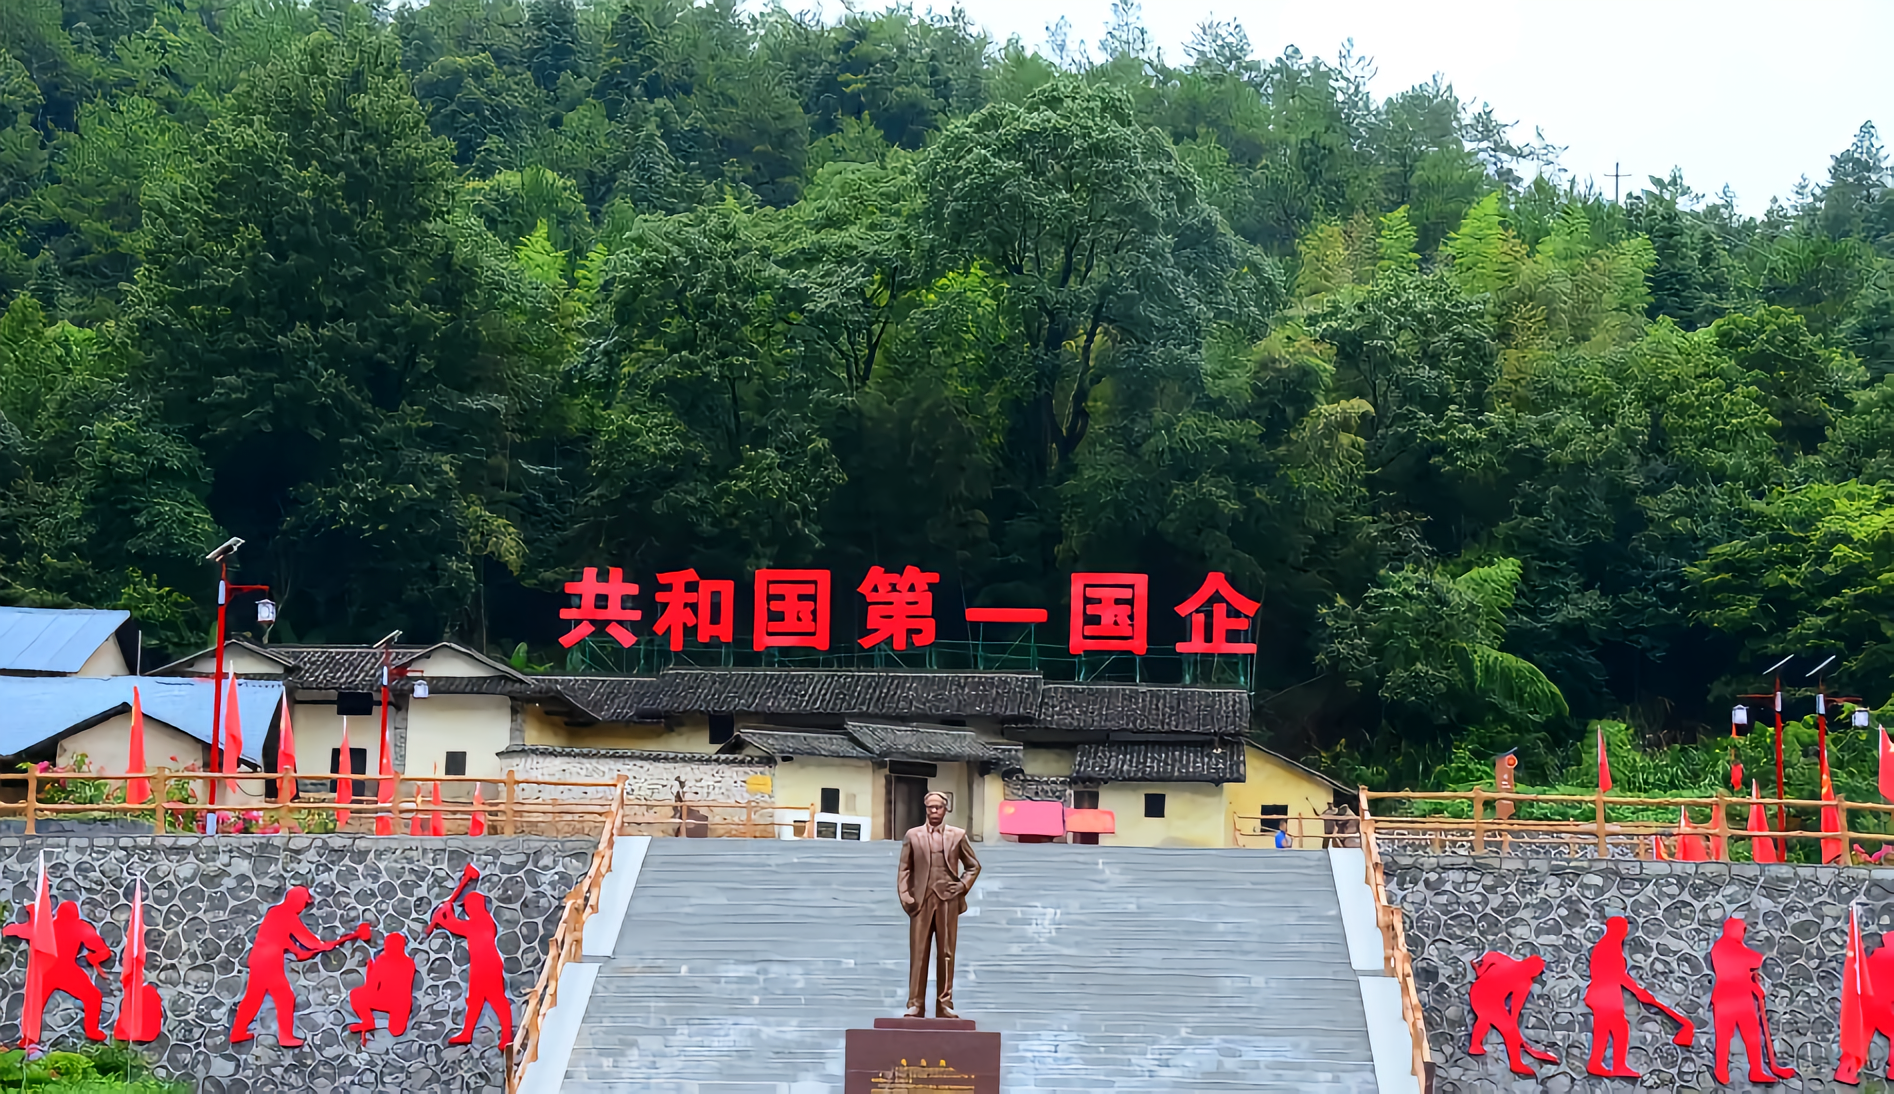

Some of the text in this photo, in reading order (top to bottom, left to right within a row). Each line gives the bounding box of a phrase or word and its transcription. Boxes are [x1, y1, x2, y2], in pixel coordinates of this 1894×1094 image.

[558, 564, 1261, 656] 共和国第一国企
